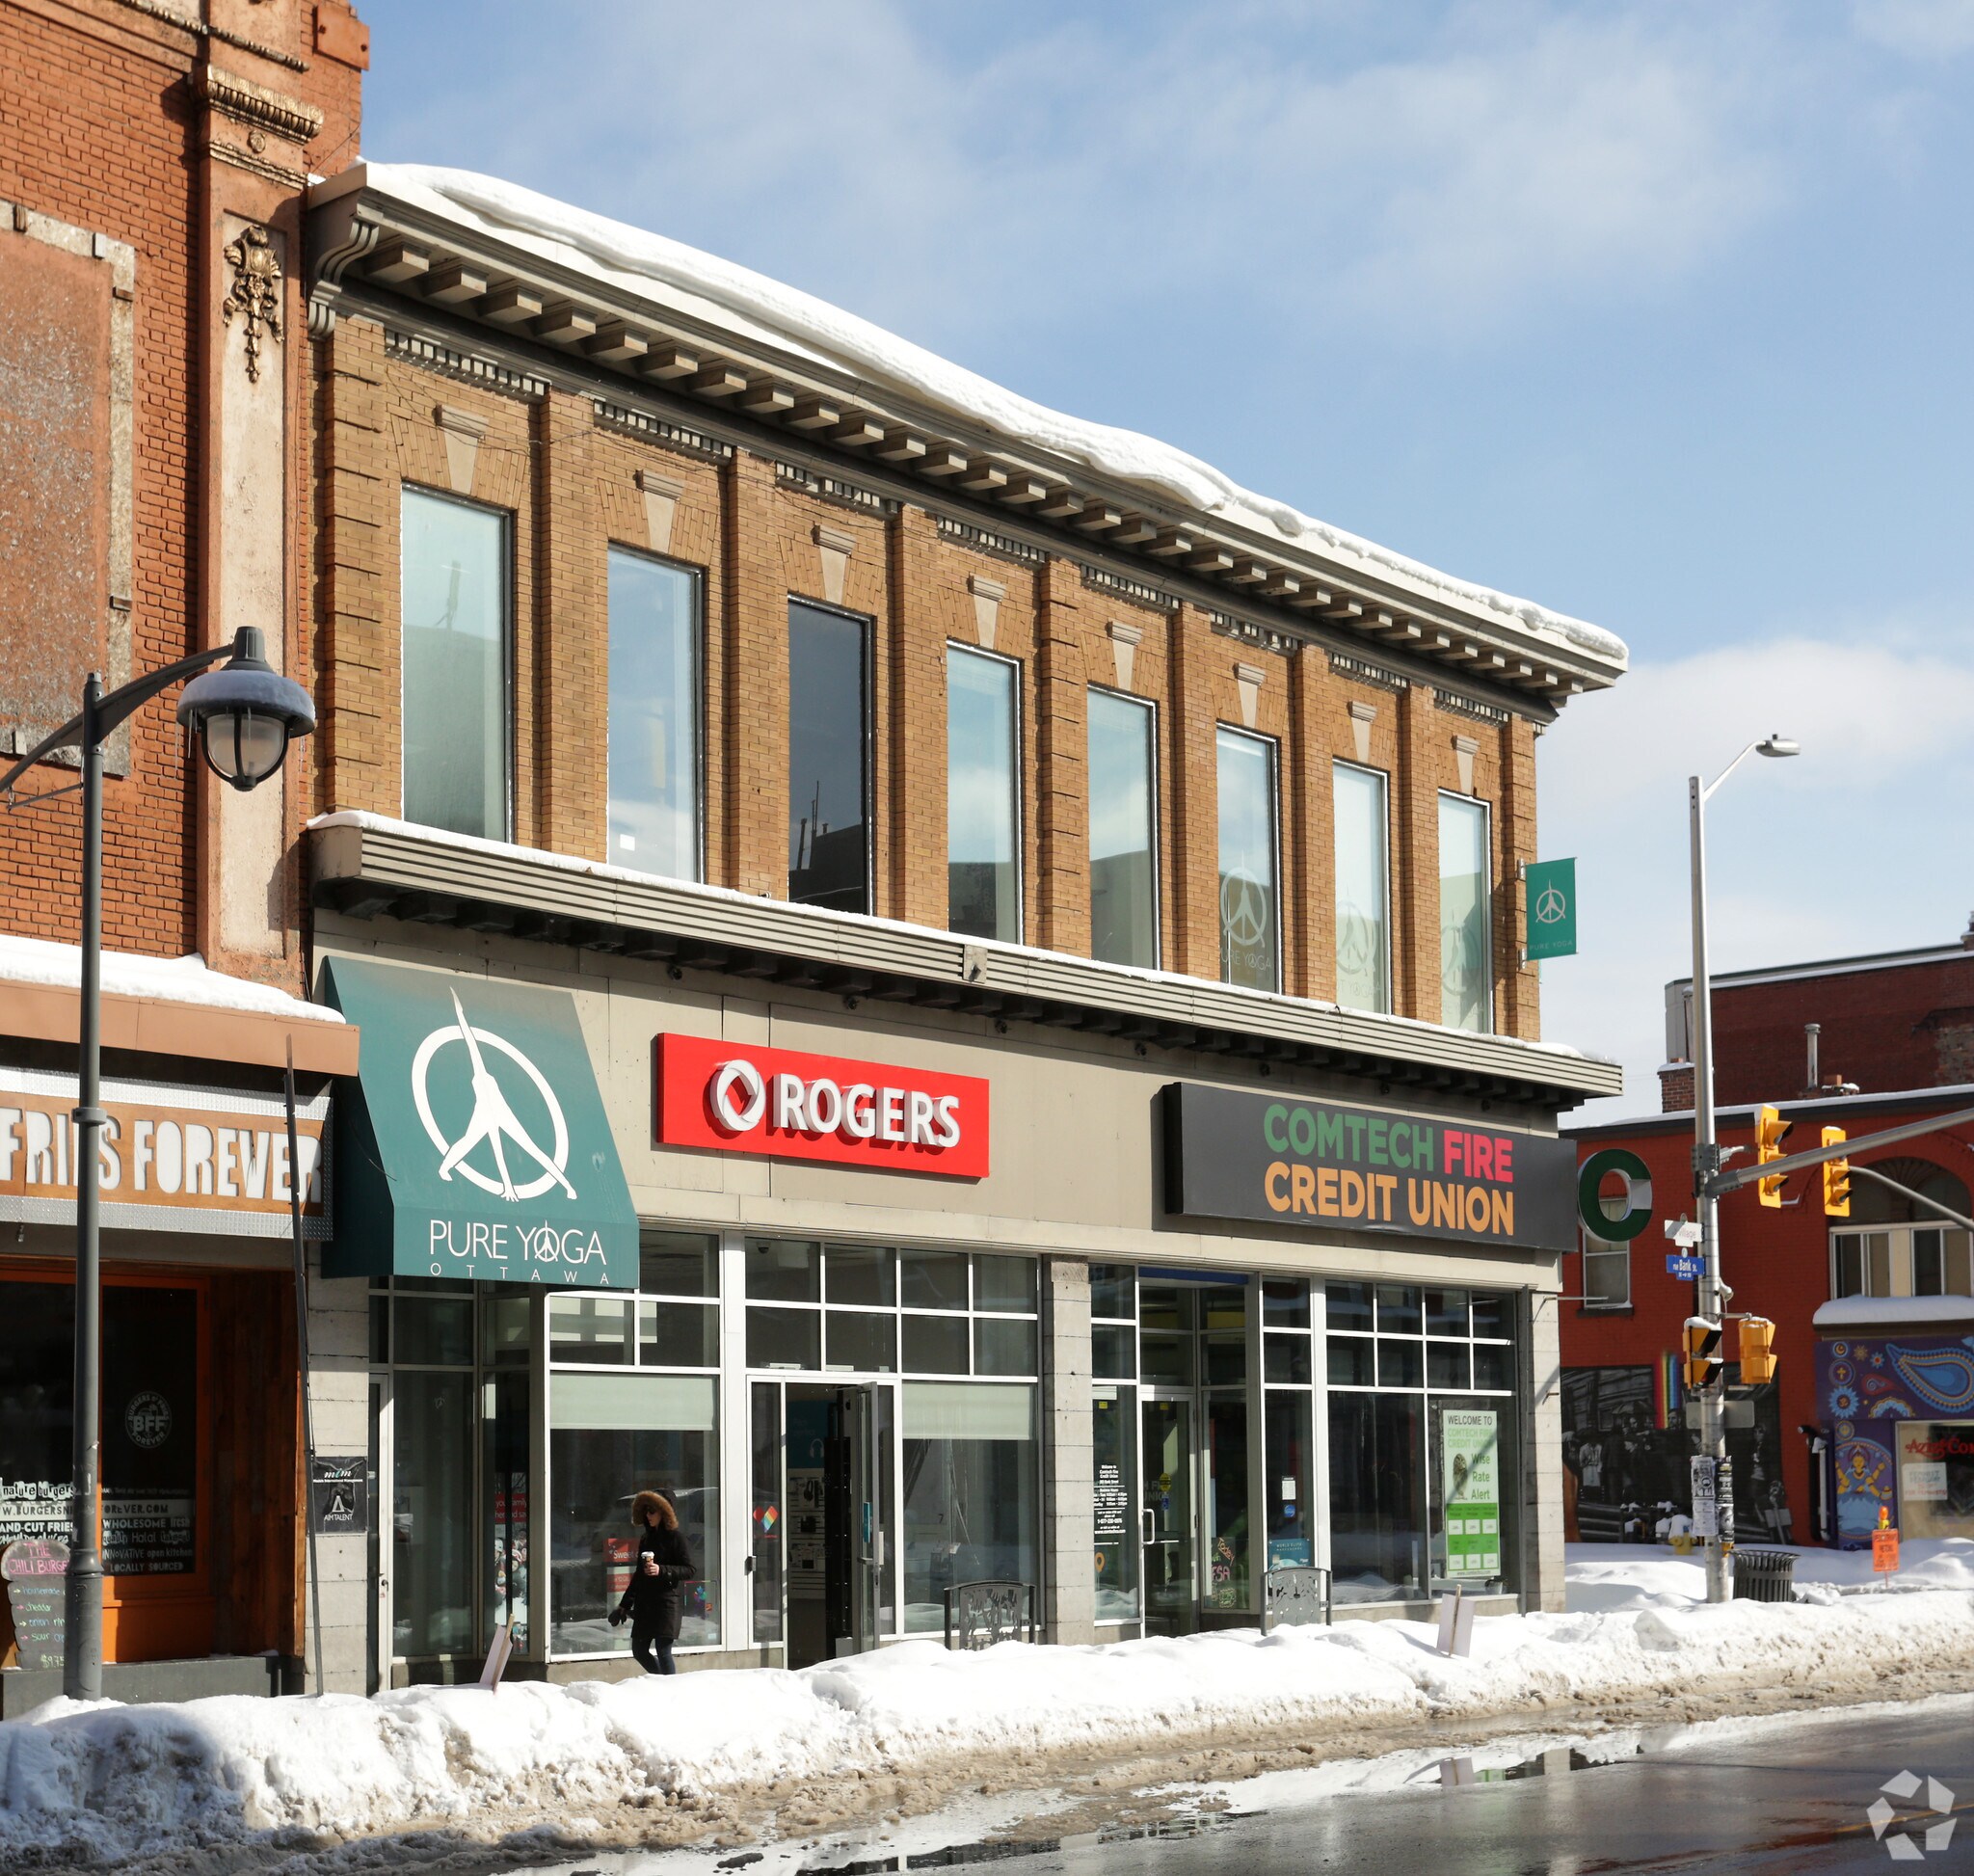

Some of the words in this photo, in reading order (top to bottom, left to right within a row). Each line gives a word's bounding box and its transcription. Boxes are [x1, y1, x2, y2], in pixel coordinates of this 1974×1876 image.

[1219, 947, 1240, 964] URE
[773, 1073, 961, 1148] ROGERS
[1264, 1104, 1433, 1171] COMTECH
[1443, 1130, 1513, 1183] FIRE
[0, 1108, 121, 1190] FRIS
[134, 1119, 322, 1203] FOREVER
[1264, 1160, 1398, 1221] CREDIT
[1407, 1177, 1514, 1236] UNION
[430, 1219, 508, 1260] PURE
[516, 1220, 607, 1265] YOGA
[1679, 1259, 1692, 1272] Bank
[430, 1262, 609, 1285] OTTAWA
[134, 1415, 168, 1432] BFF
[1448, 1415, 1481, 1425] WELCOME
[1484, 1416, 1492, 1425] TO
[1471, 1453, 1490, 1464] Wise
[1472, 1471, 1490, 1482] Rate
[1471, 1488, 1490, 1500] Alert
[102, 1518, 166, 1529] WHOLESOME
[8, 1559, 35, 1574] CHILI
[38, 1559, 69, 1574] BURGE
[110, 1563, 145, 1573] LOCALLY
[147, 1562, 185, 1571] SOURCED
[31, 1632, 50, 1642] sour
